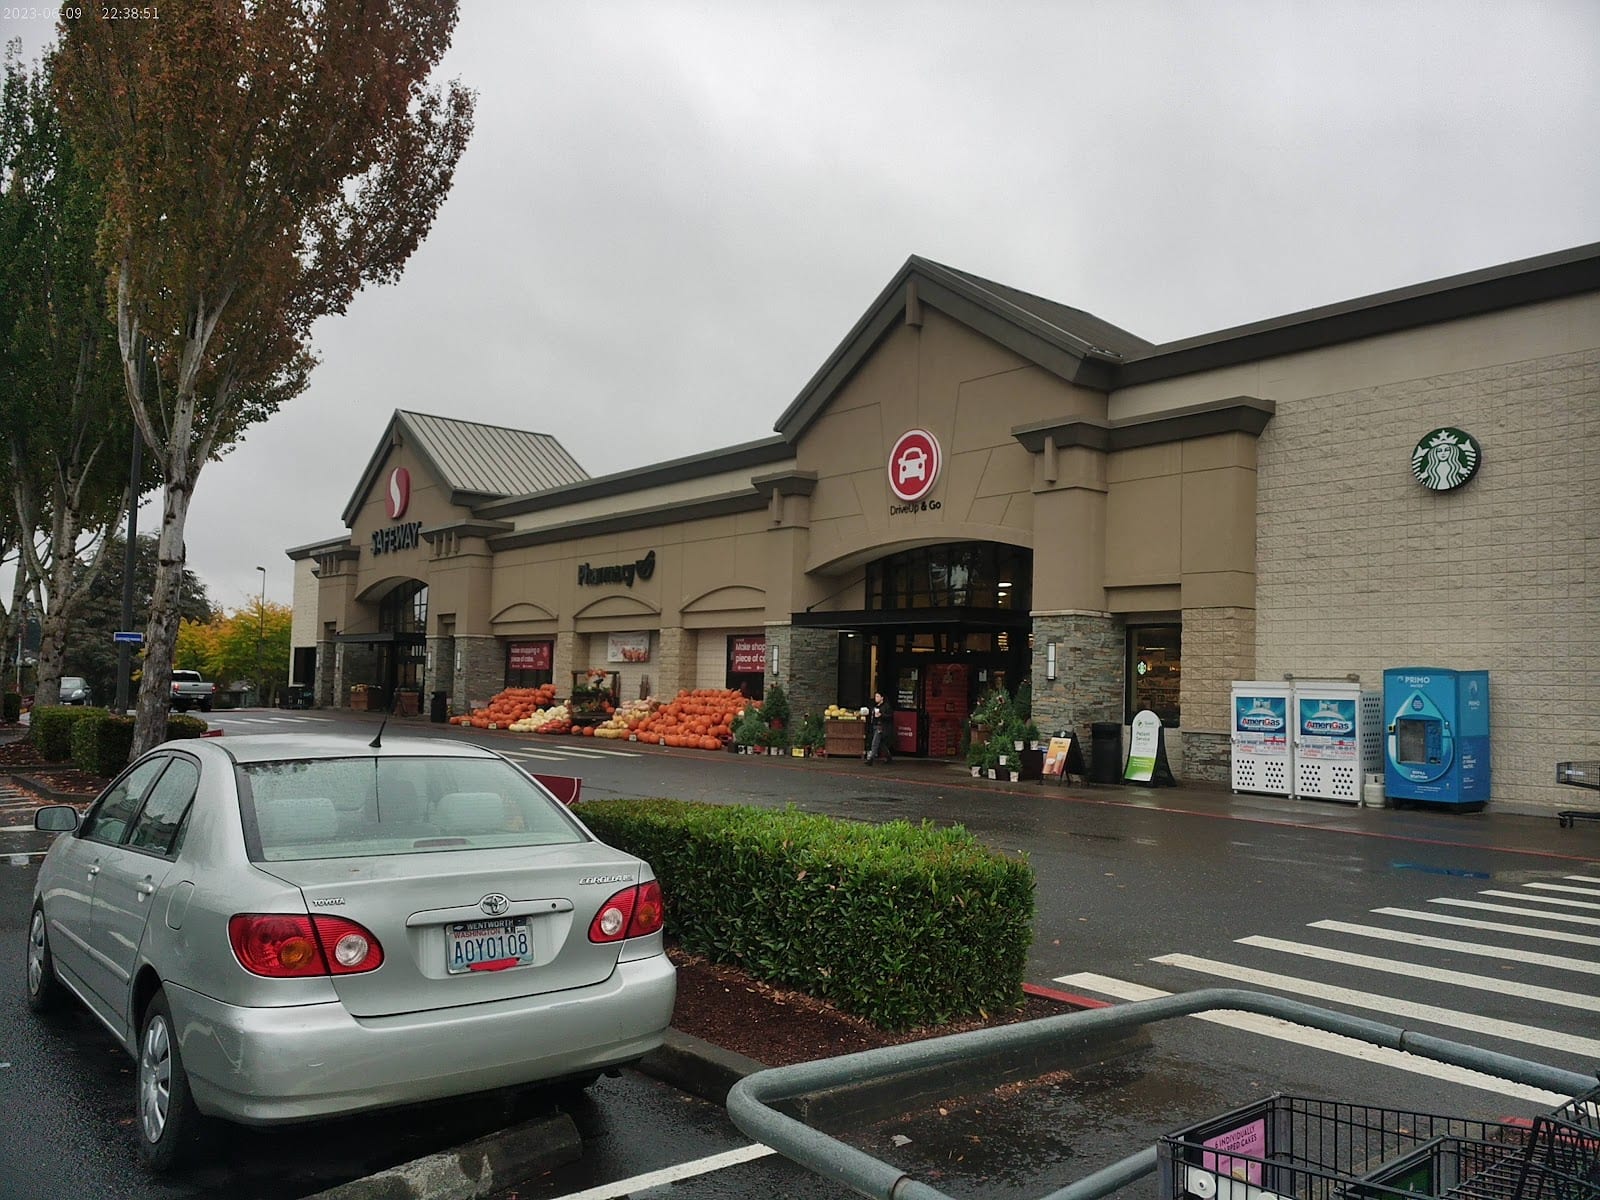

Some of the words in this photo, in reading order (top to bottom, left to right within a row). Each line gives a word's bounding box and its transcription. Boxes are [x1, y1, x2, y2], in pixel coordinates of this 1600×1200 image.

[890, 503, 919, 515] DriveUp
[920, 501, 927, 511] &
[929, 500, 941, 510] Go
[371, 520, 422, 556] SAFEWAY
[578, 562, 635, 587] Pharmacy
[735, 643, 751, 651] Make
[1404, 676, 1430, 684] PRIMO
[1242, 718, 1281, 727] AmeriGas
[1306, 721, 1350, 730] AmeriGas
[312, 898, 345, 907] TOYOTA
[466, 920, 513, 930] WENTWORTH
[453, 928, 500, 938] WASHINGTON
[1219, 1126, 1255, 1147] INDIVIDUALLY
[1240, 1133, 1257, 1147] CAKES
